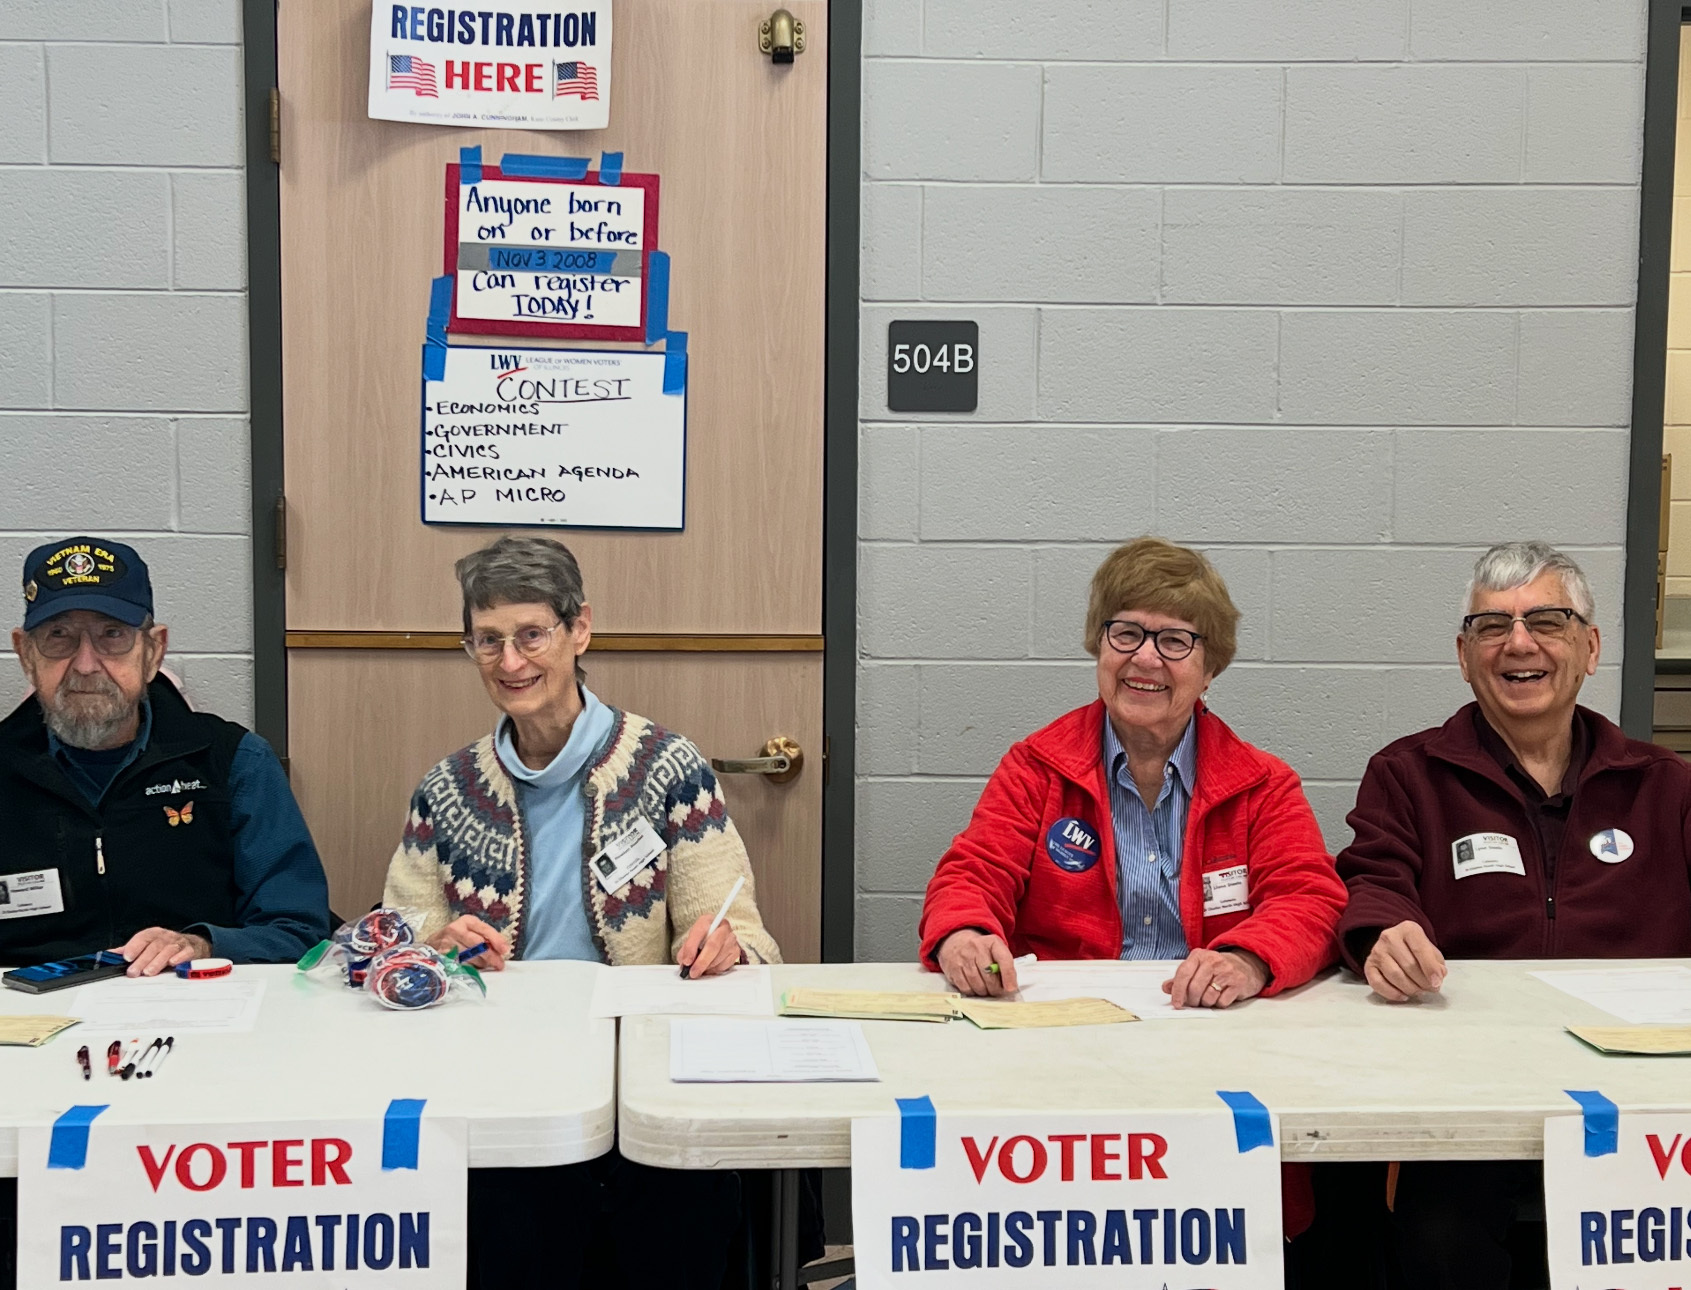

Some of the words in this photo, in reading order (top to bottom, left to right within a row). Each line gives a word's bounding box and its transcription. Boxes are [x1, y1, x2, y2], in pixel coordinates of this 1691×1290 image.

[391, 4, 597, 47] REGISTRATION
[445, 60, 544, 93] HERE
[466, 186, 552, 226] Anyone
[569, 191, 622, 216] born
[531, 227, 556, 242] or
[570, 221, 638, 245] before
[535, 251, 546, 267] 3
[553, 252, 597, 268] 2008
[472, 270, 516, 293] Can
[534, 272, 630, 301] register
[490, 354, 521, 370] LWV
[893, 344, 974, 373] 504B
[496, 376, 631, 402] CONTEST
[436, 402, 539, 415] ECONOMICS
[434, 424, 568, 442] GOVERNMENT
[433, 444, 500, 459] CIVICS
[432, 463, 545, 480] AMERICAN
[559, 465, 640, 482] AGENDA
[440, 489, 476, 505] AP
[496, 487, 566, 502] MICRO
[46, 545, 90, 566] VIETNAM
[1062, 821, 1095, 850] LWV
[136, 1138, 353, 1193] VOTER
[960, 1133, 1169, 1185] VOTER
[1645, 1133, 1691, 1181] V
[60, 1211, 430, 1281] REGISTRATION
[891, 1208, 1247, 1272] REGISTRATION
[1581, 1206, 1691, 1266] REGI
